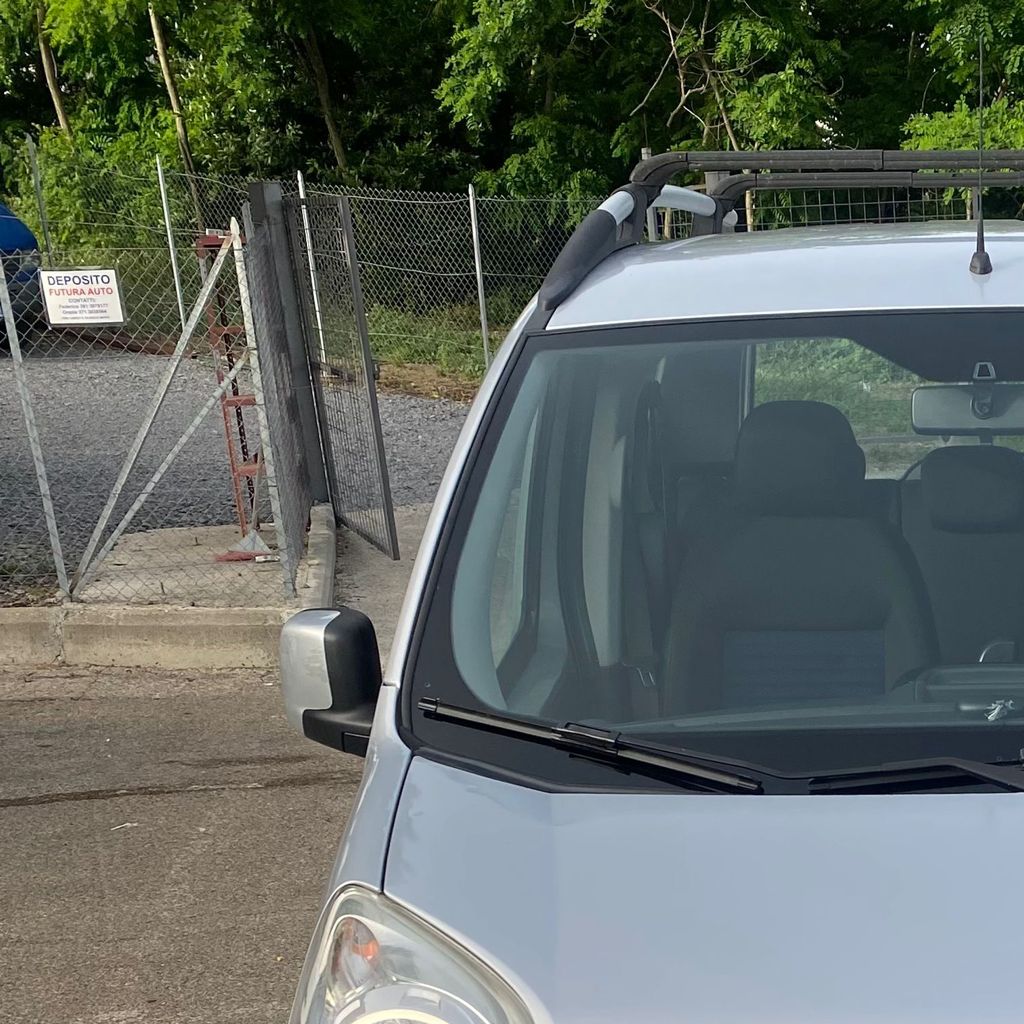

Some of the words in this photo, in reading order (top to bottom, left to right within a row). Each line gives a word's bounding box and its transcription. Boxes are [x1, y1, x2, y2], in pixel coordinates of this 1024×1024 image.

[47, 275, 110, 286] DEPOSITO
[49, 288, 86, 296] FUTURA
[88, 287, 114, 295] AUTO
